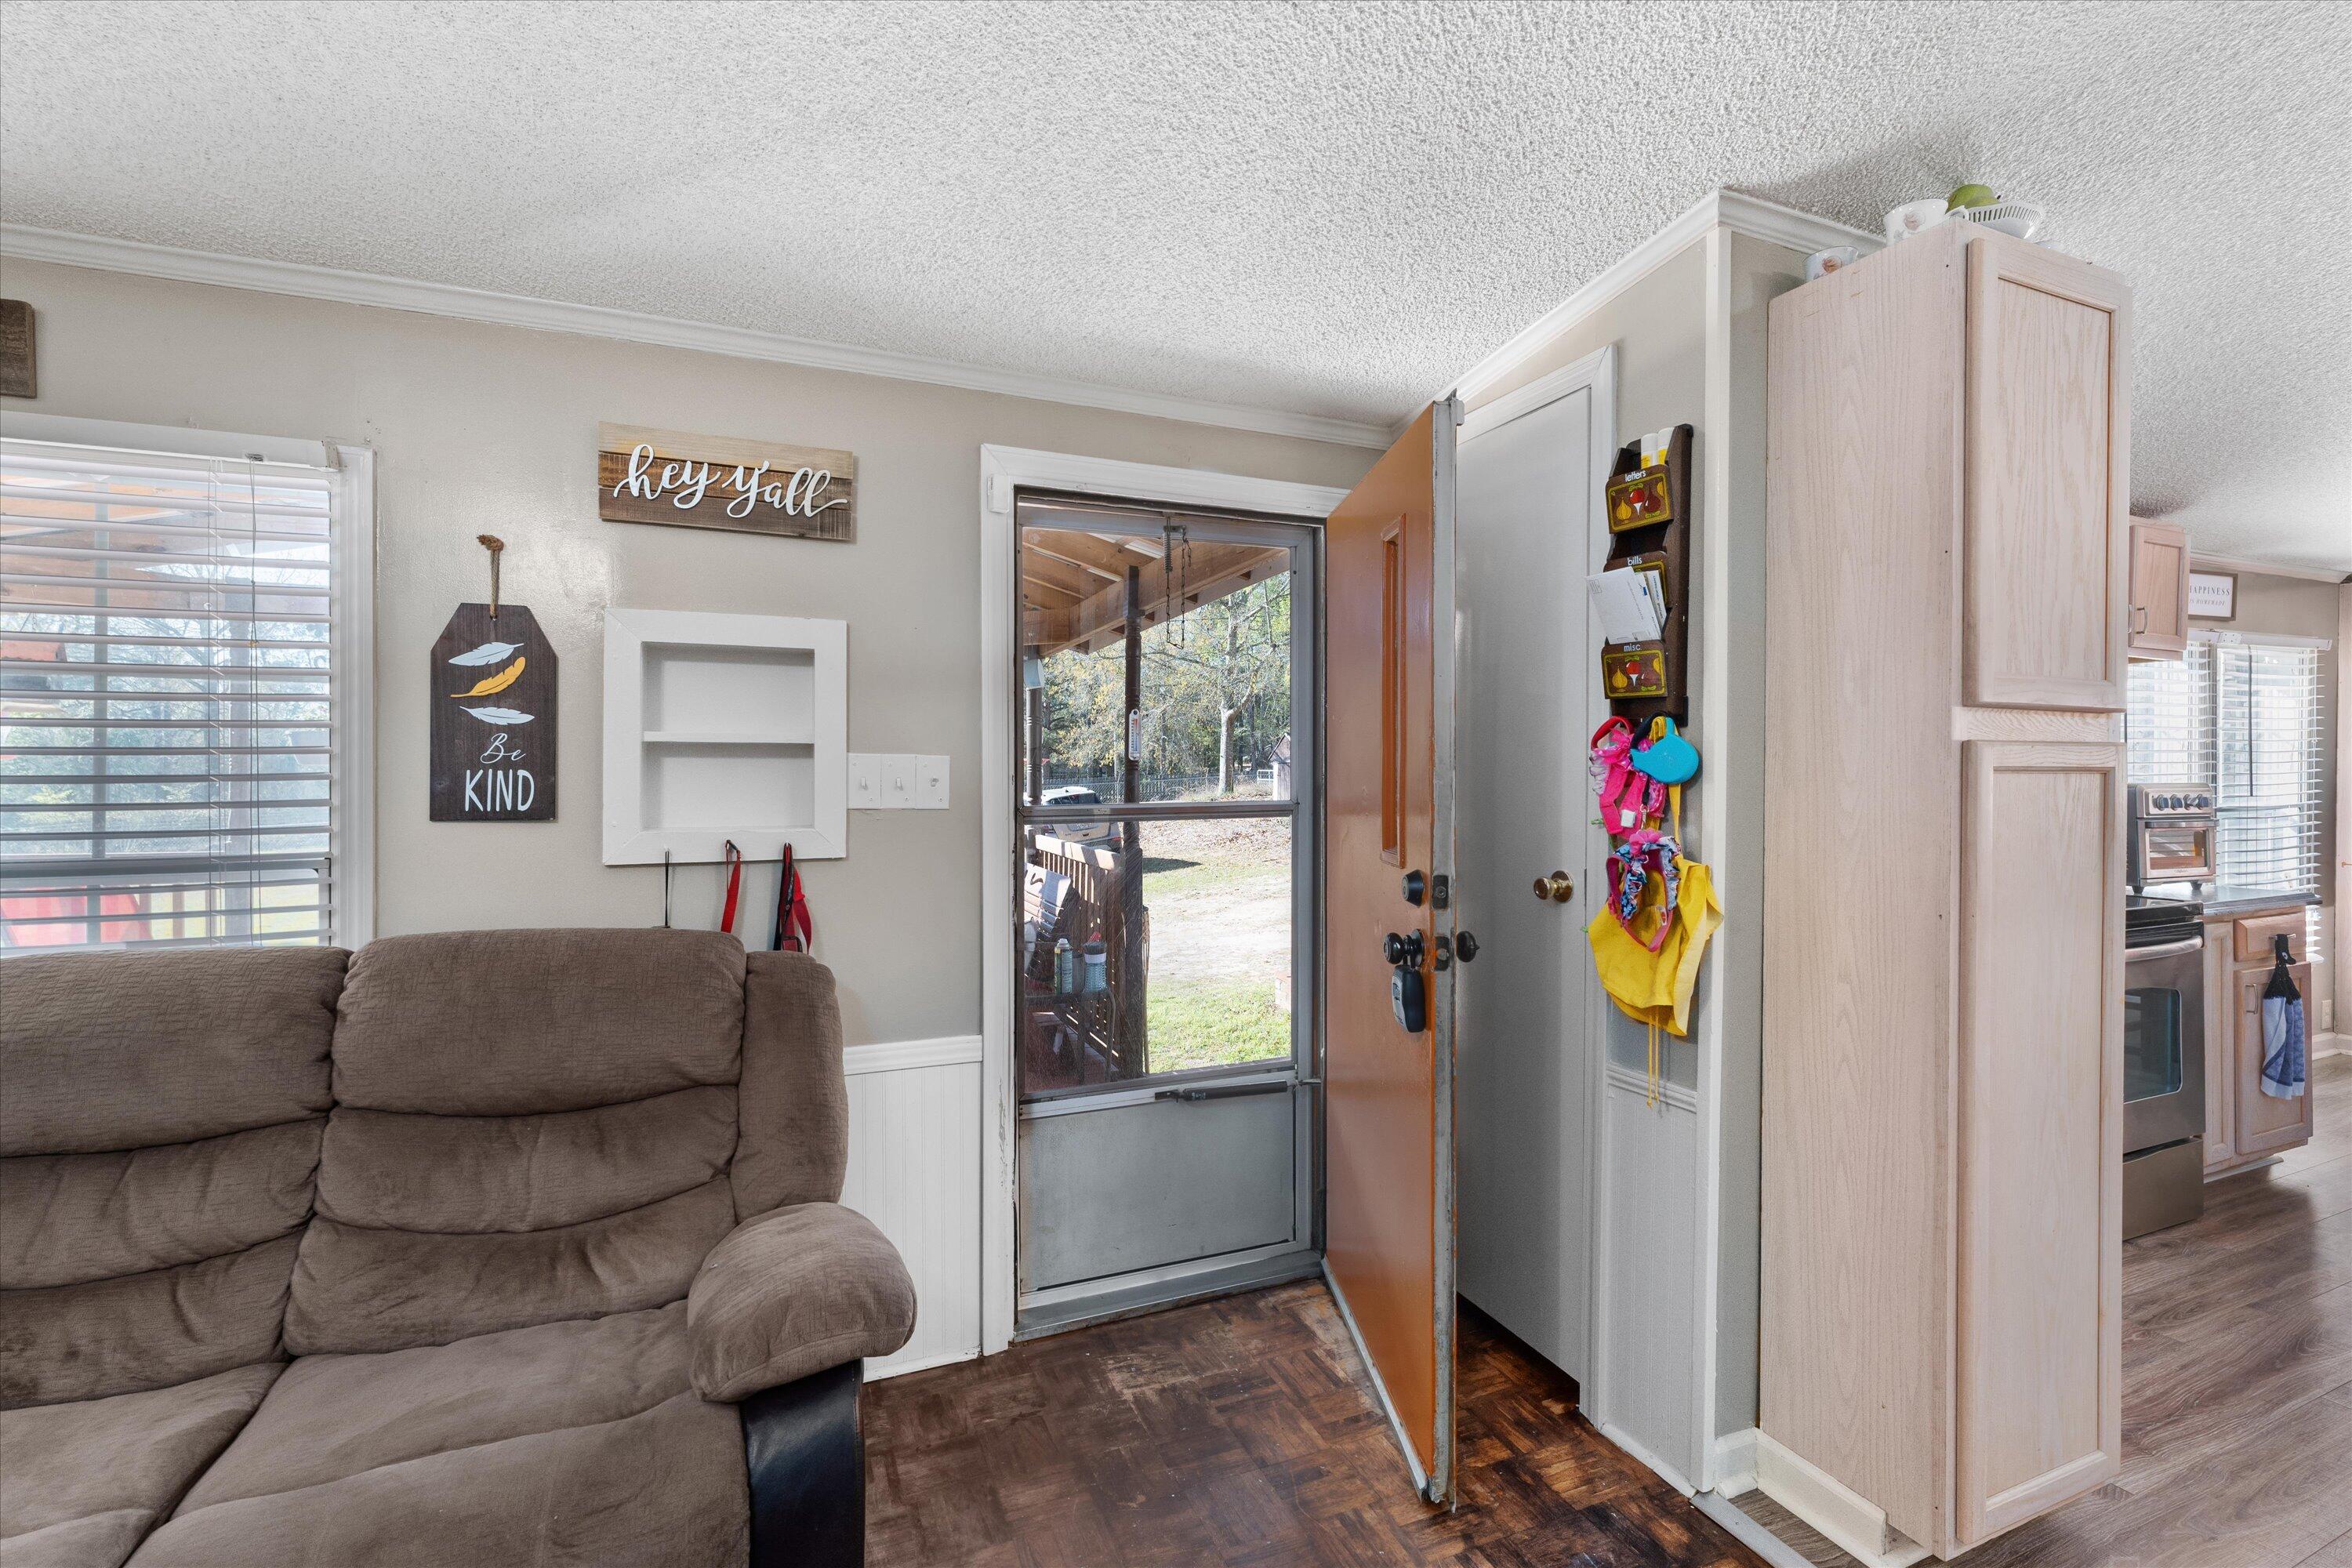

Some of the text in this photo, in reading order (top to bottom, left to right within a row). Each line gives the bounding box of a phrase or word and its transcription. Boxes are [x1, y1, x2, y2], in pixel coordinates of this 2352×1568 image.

[614, 444, 848, 517] hey y'all
[1625, 470, 1646, 482] letters
[1627, 556, 1642, 566] bills
[480, 733, 526, 764] Be
[465, 769, 535, 811] KIND
